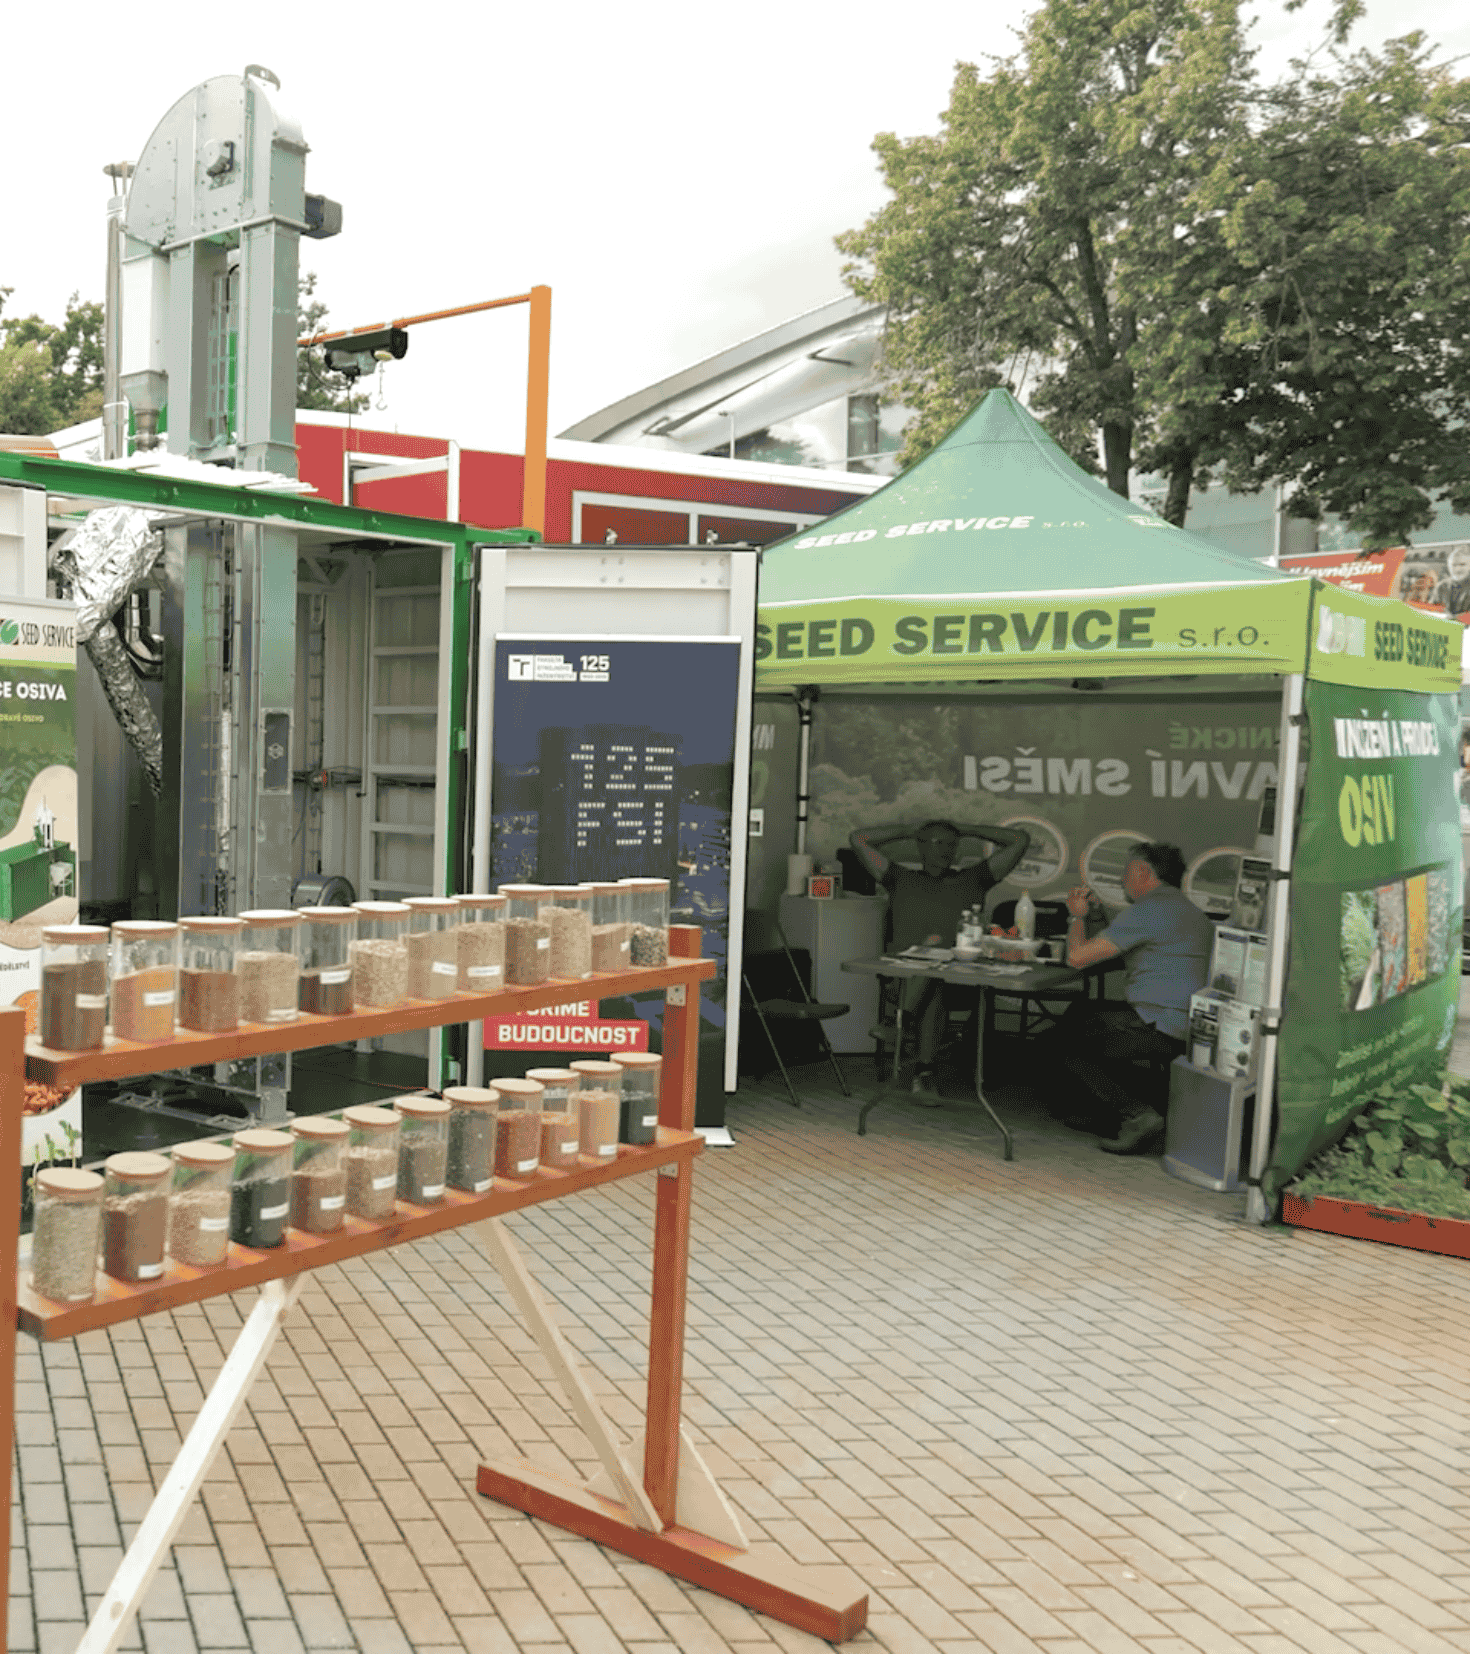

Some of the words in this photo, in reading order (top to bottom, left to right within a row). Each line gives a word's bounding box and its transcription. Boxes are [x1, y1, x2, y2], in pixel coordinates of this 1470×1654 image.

[794, 529, 877, 550] SEED
[884, 515, 1035, 539] SERVICE
[21, 622, 40, 646] SEED
[42, 624, 75, 649] SERVICE
[892, 606, 1156, 655] SERVICE
[1178, 625, 1270, 647] s.r.o.
[1374, 620, 1404, 662] SEED
[1406, 627, 1449, 670] SERVICE
[579, 654, 610, 672] 125
[16, 681, 67, 701] OSIVA
[571, 743, 675, 790] 125
[576, 801, 664, 847] FSI
[498, 1024, 641, 1045] BUDOUCNOST
